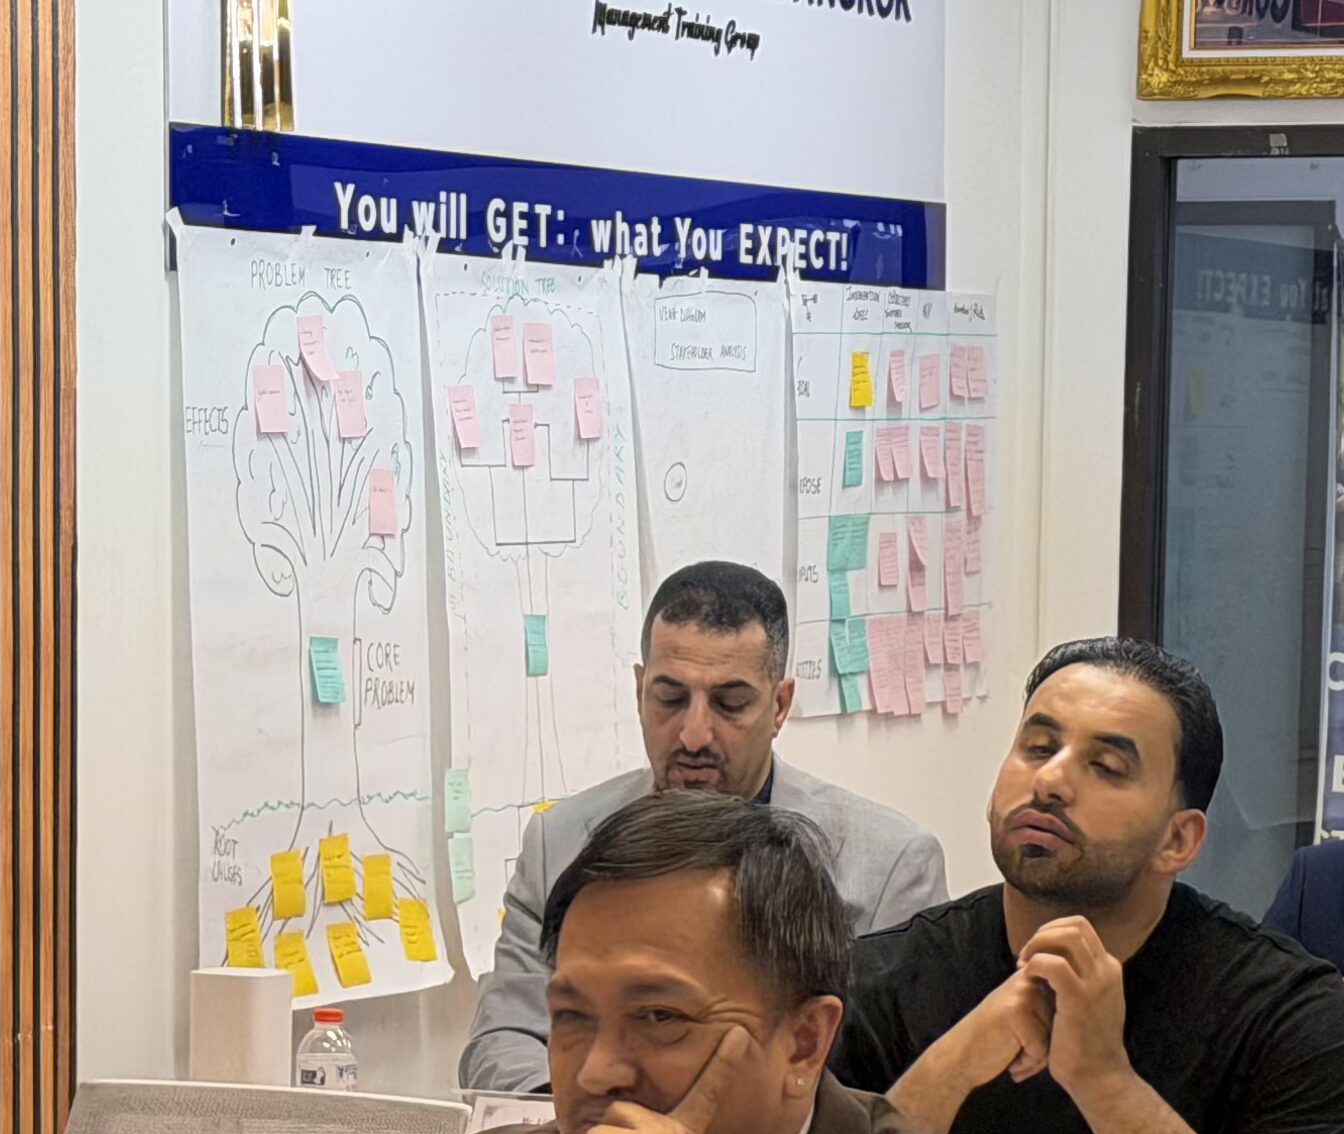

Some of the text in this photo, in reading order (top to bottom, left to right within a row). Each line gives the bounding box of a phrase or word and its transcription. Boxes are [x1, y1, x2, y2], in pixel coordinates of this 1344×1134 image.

[334, 182, 848, 271] You will GET: what You EXPECT!
[251, 260, 352, 290] PROBLEM TREE
[185, 406, 229, 435] EFFECTS
[367, 642, 400, 672] CORE
[365, 679, 415, 710] PROBLEM
